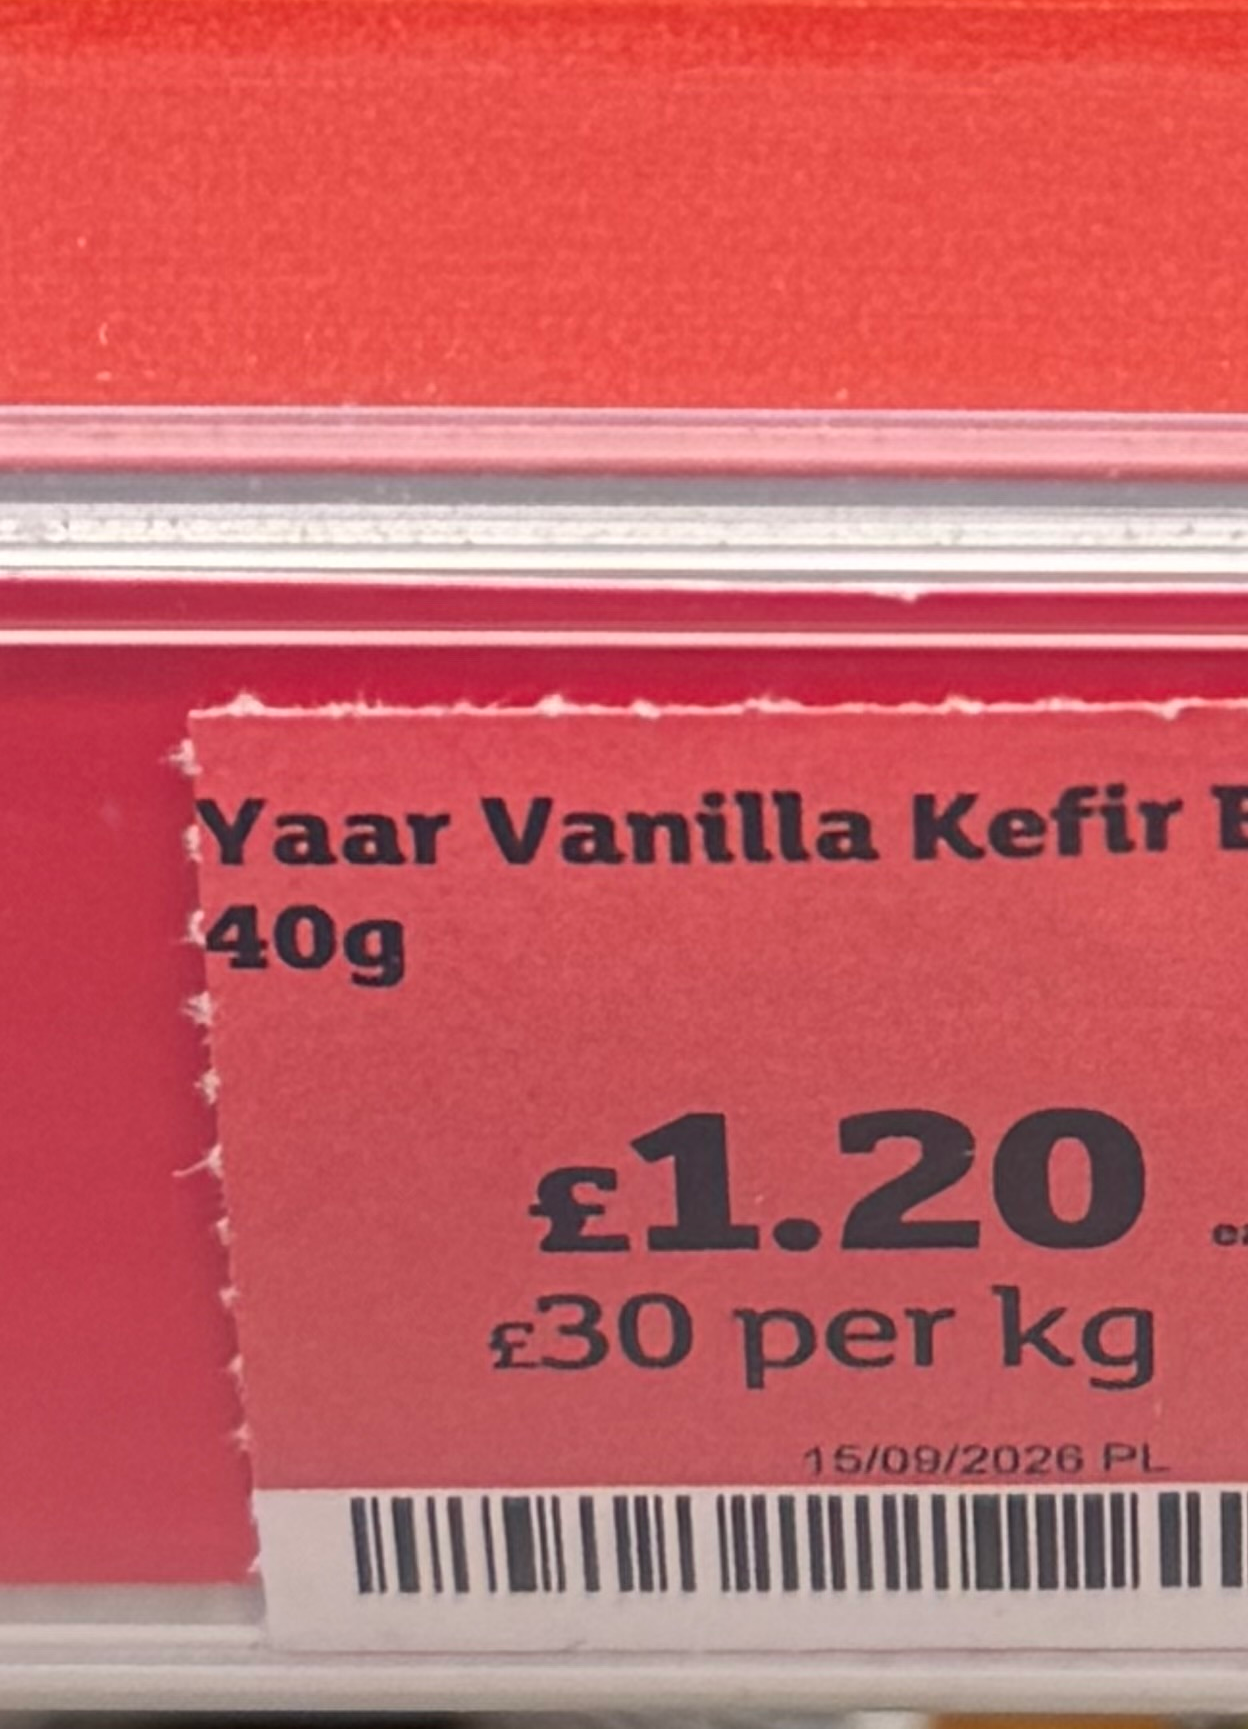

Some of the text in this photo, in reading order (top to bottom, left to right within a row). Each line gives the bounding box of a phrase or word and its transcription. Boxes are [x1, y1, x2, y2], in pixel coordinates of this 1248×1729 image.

[199, 799, 450, 866] Yaar
[481, 791, 879, 865] Vanilla
[913, 783, 1182, 860] Kefir
[206, 905, 404, 988] 40g
[529, 1108, 1145, 1253] £1.20
[489, 1285, 1154, 1391] £30 per kg
[805, 1443, 1168, 1476] 15/09/2026 PL
